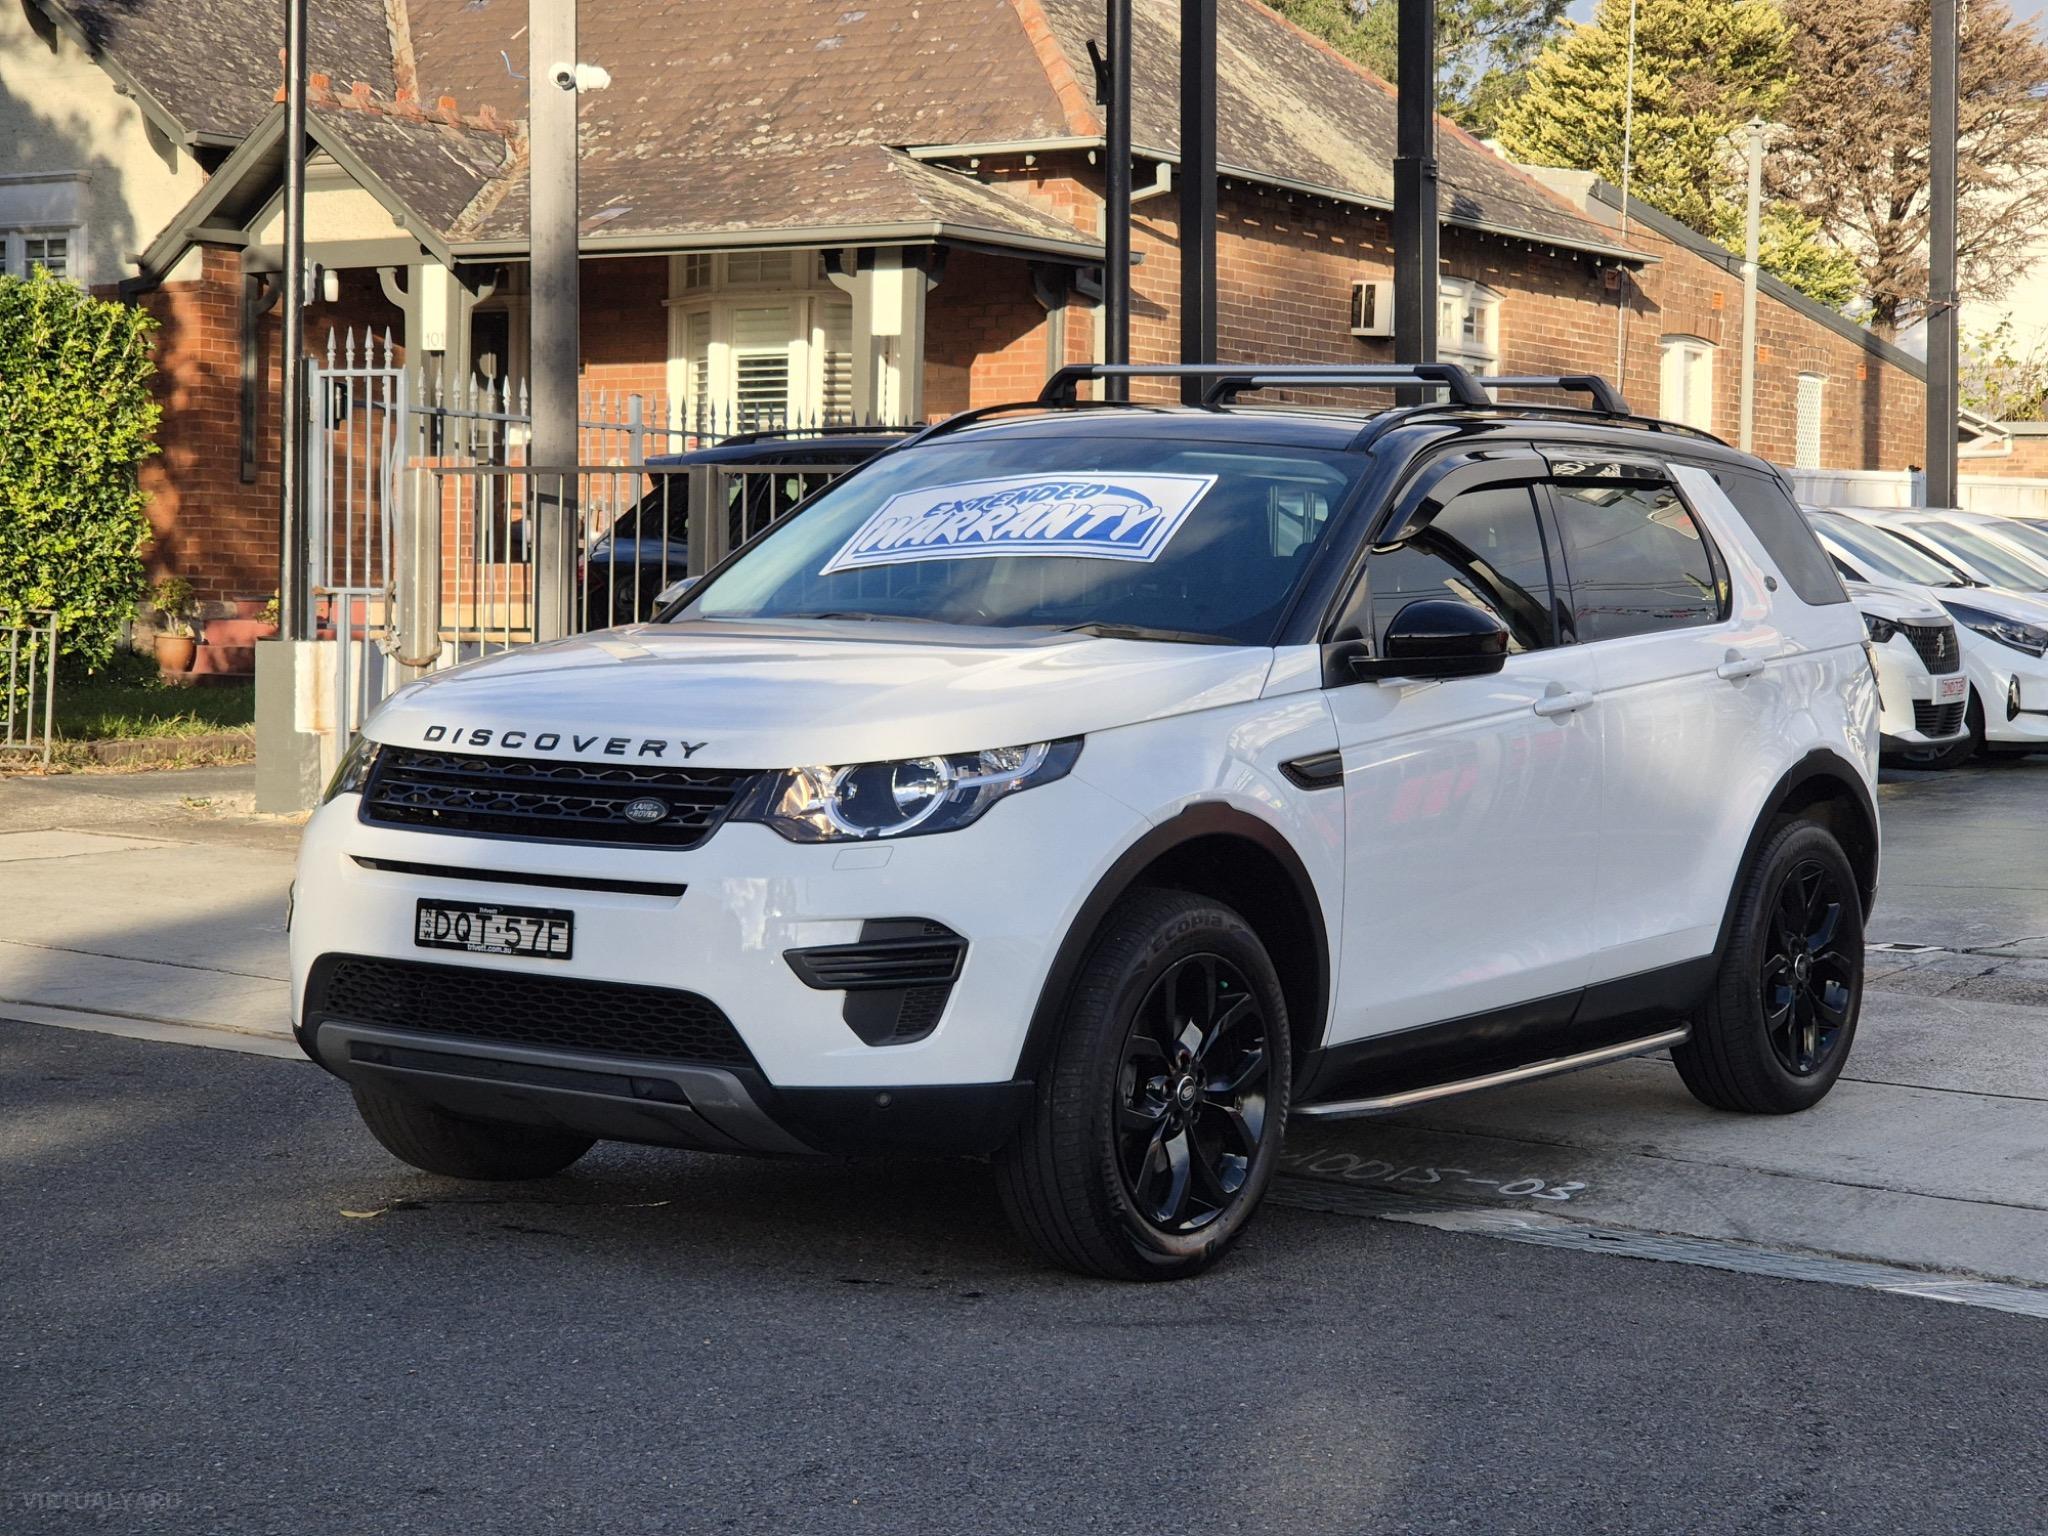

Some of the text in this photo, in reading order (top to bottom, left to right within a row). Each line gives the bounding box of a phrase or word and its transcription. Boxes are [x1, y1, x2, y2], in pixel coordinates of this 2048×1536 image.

[923, 484, 1108, 518] EXTENDED
[858, 503, 1162, 551] WARRANTY
[423, 725, 709, 759] DISCOVERY
[633, 810, 658, 818] ROVER
